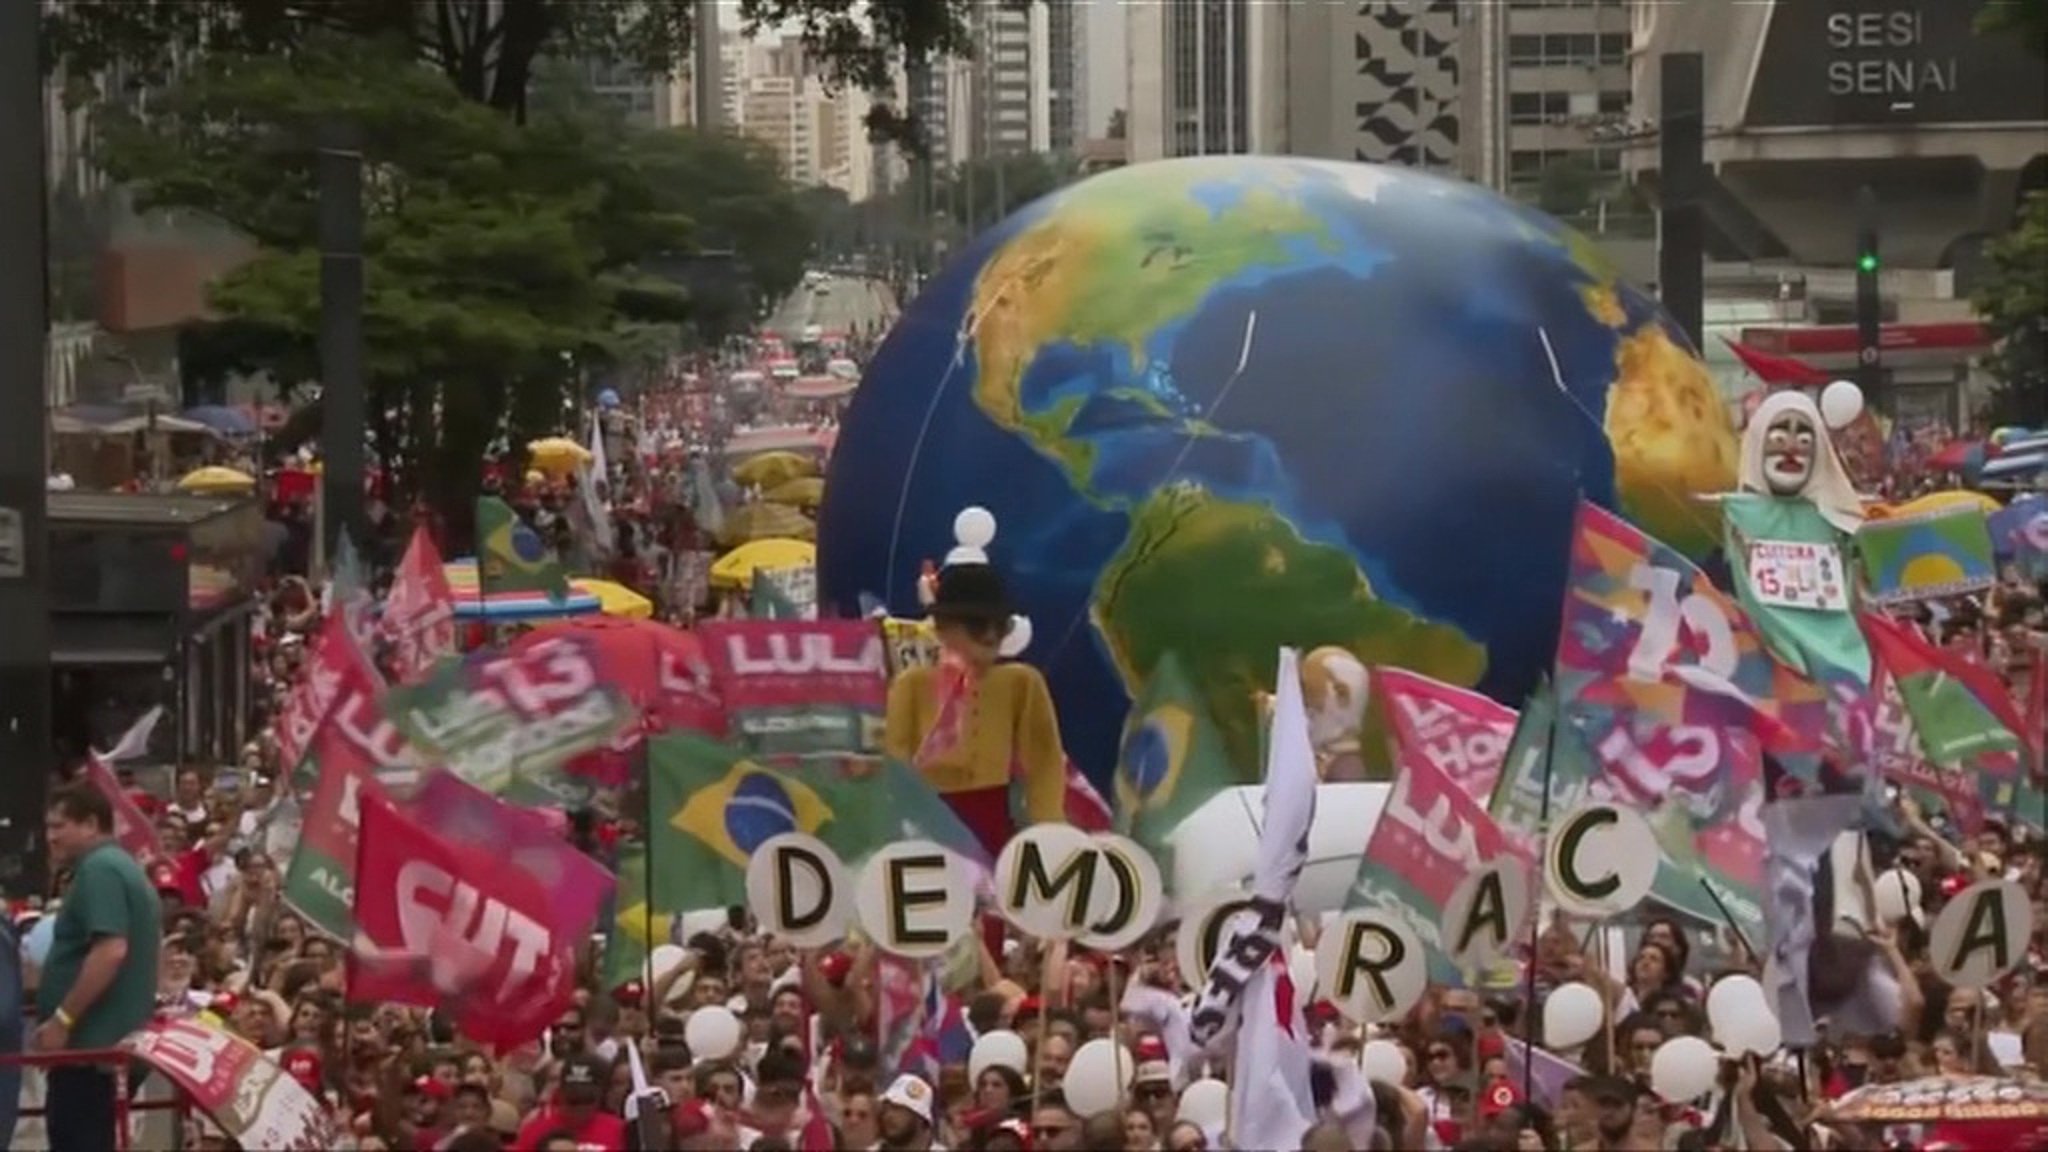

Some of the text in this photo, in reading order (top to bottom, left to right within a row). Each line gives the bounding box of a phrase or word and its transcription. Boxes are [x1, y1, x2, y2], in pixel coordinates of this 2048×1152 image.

[1827, 11, 1922, 47] SESI
[1827, 58, 1957, 94] SENAI
[396, 858, 551, 1004] CUT
